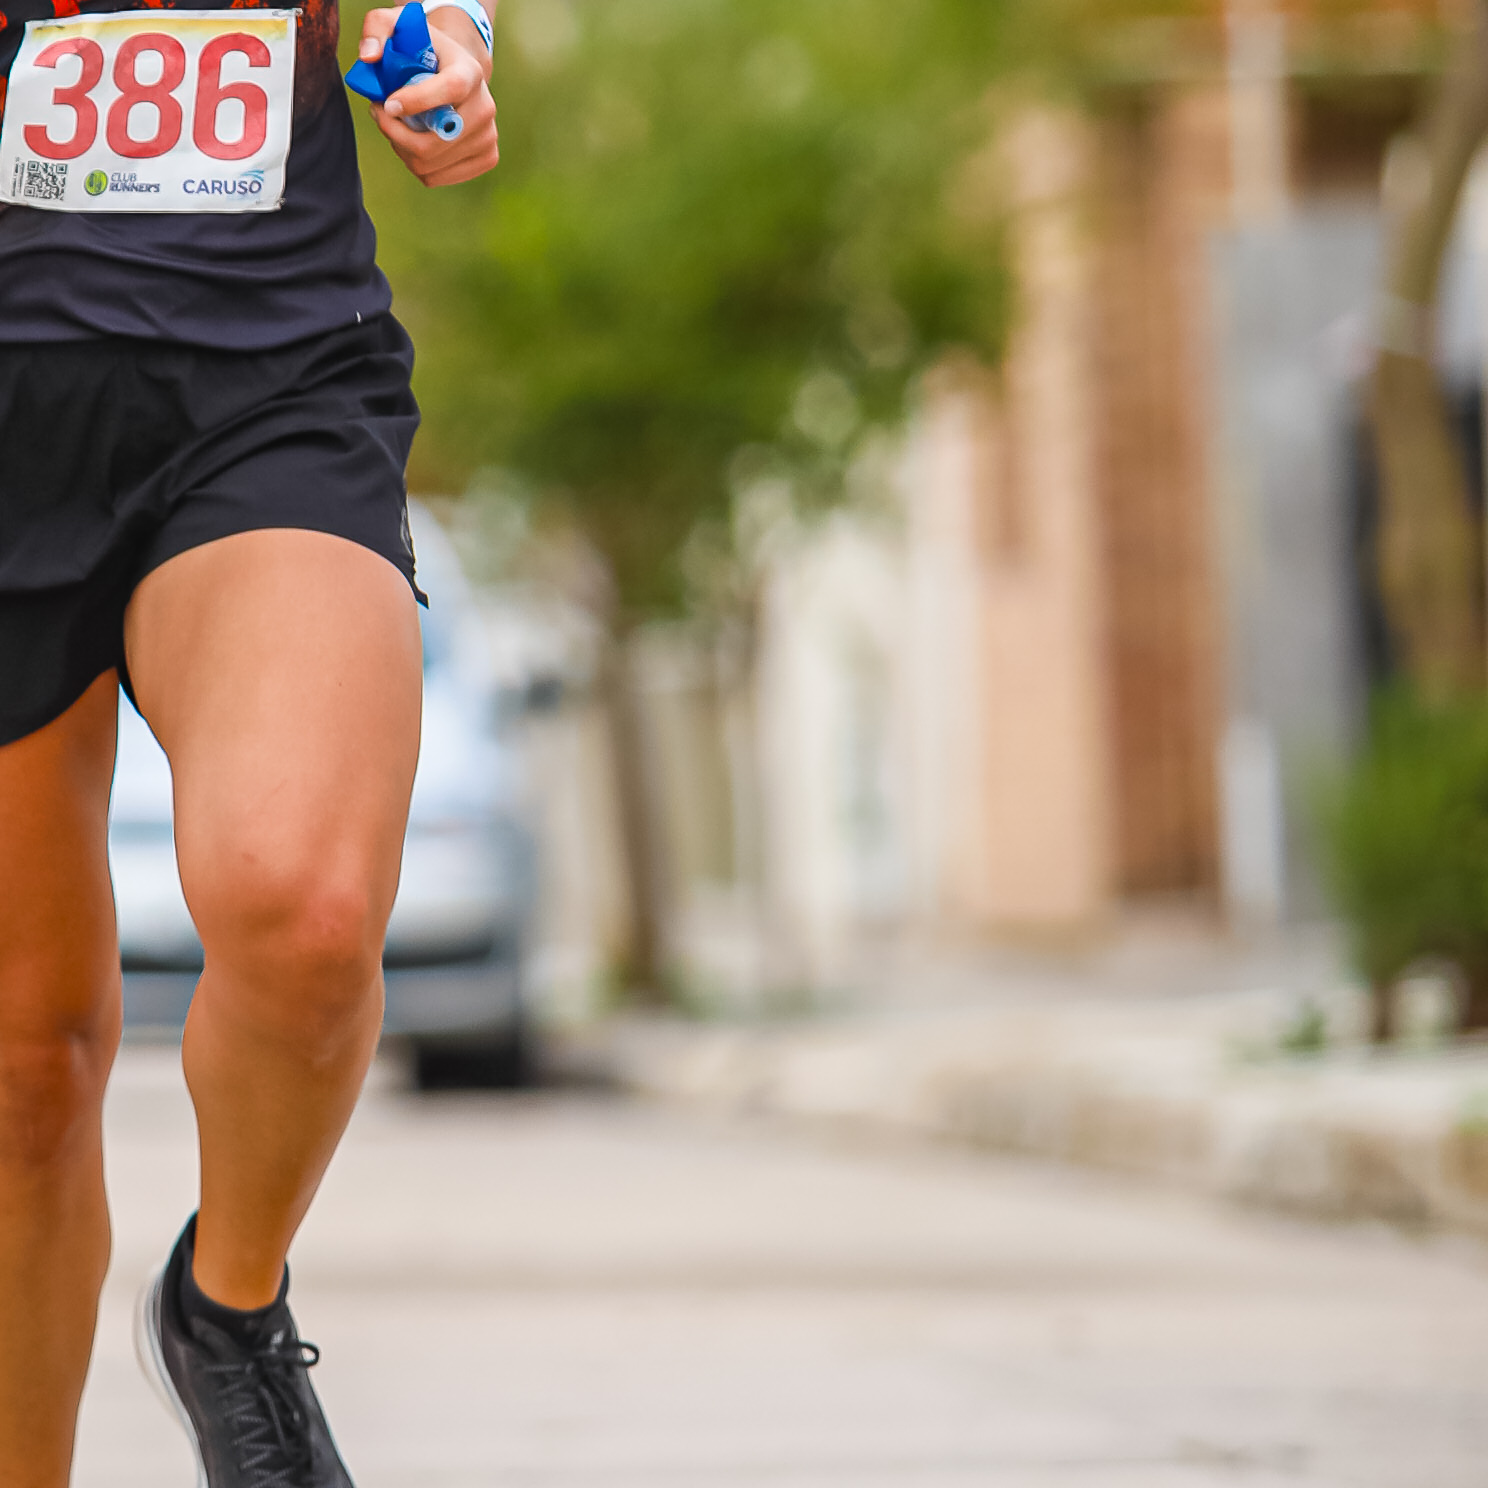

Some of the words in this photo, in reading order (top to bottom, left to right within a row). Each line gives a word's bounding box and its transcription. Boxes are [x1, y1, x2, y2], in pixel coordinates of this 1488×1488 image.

[23, 32, 271, 160] 386
[110, 172, 137, 182] CLUB
[183, 179, 262, 195] CARUSO
